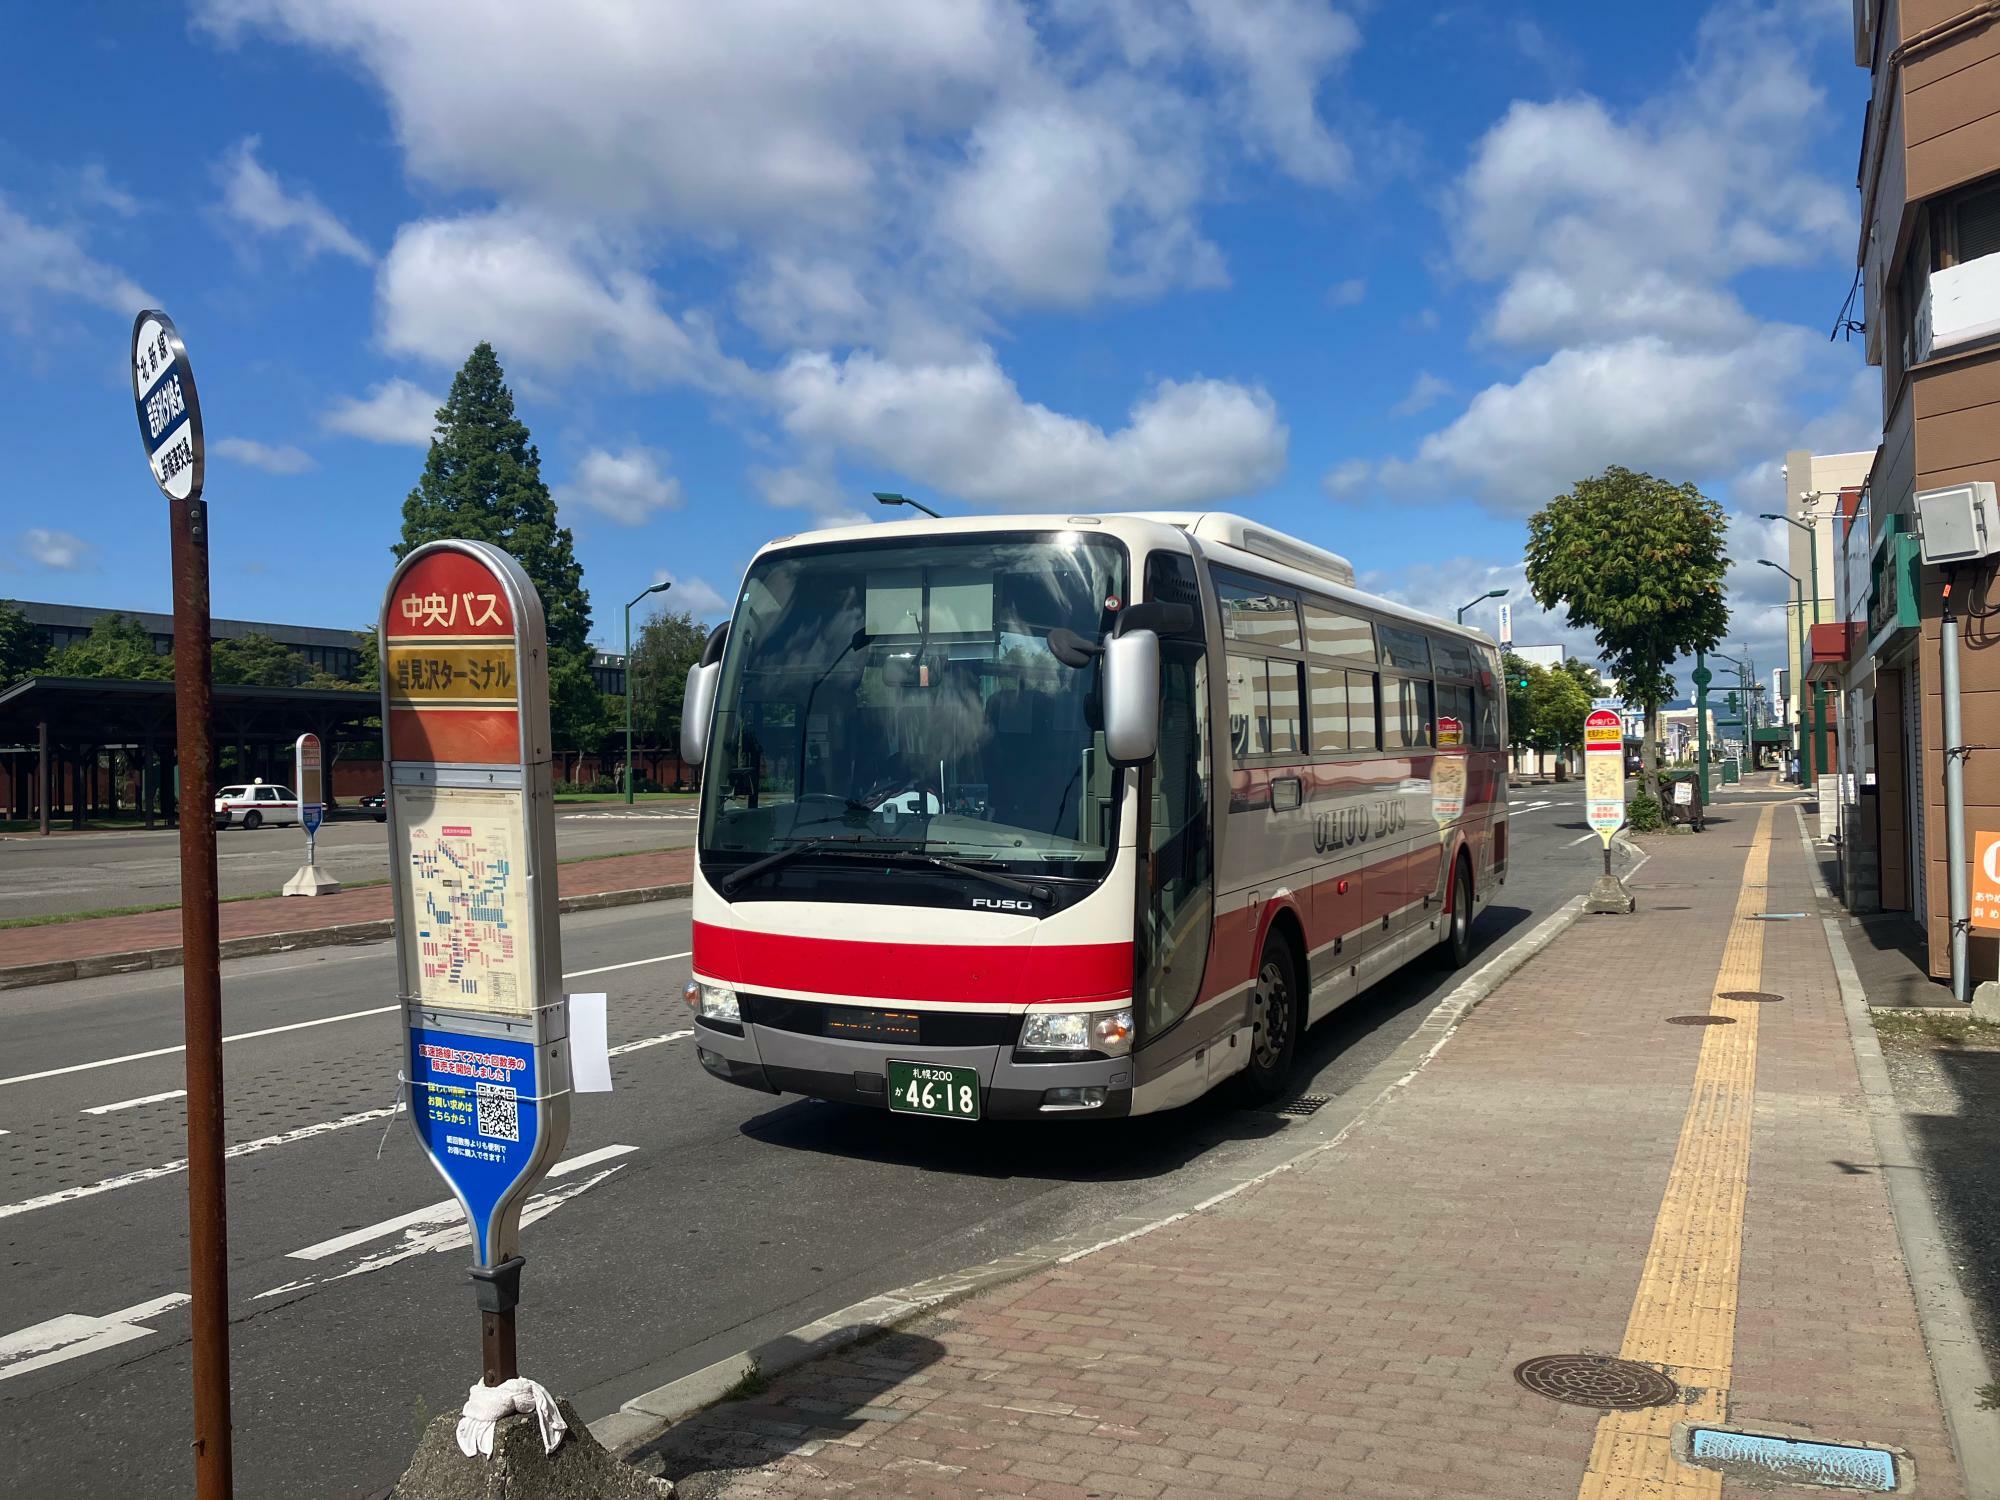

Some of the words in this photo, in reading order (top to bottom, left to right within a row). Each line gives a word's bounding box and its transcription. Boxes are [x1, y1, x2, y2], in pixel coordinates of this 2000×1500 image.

[140, 332, 169, 383] 北新線
[401, 591, 504, 628] 中央バス
[397, 658, 511, 691] 岩見沢ターミナル
[1375, 800, 1405, 838] BUS
[972, 898, 1033, 910] FUSO
[419, 1045, 525, 1071] 高速路線にてスマホ回数券の
[431, 1059, 511, 1082] 販売を開始しました！
[427, 1096, 473, 1113] お買い求めは
[906, 1079, 974, 1113] 46-18
[429, 1110, 472, 1125] こちらから！
